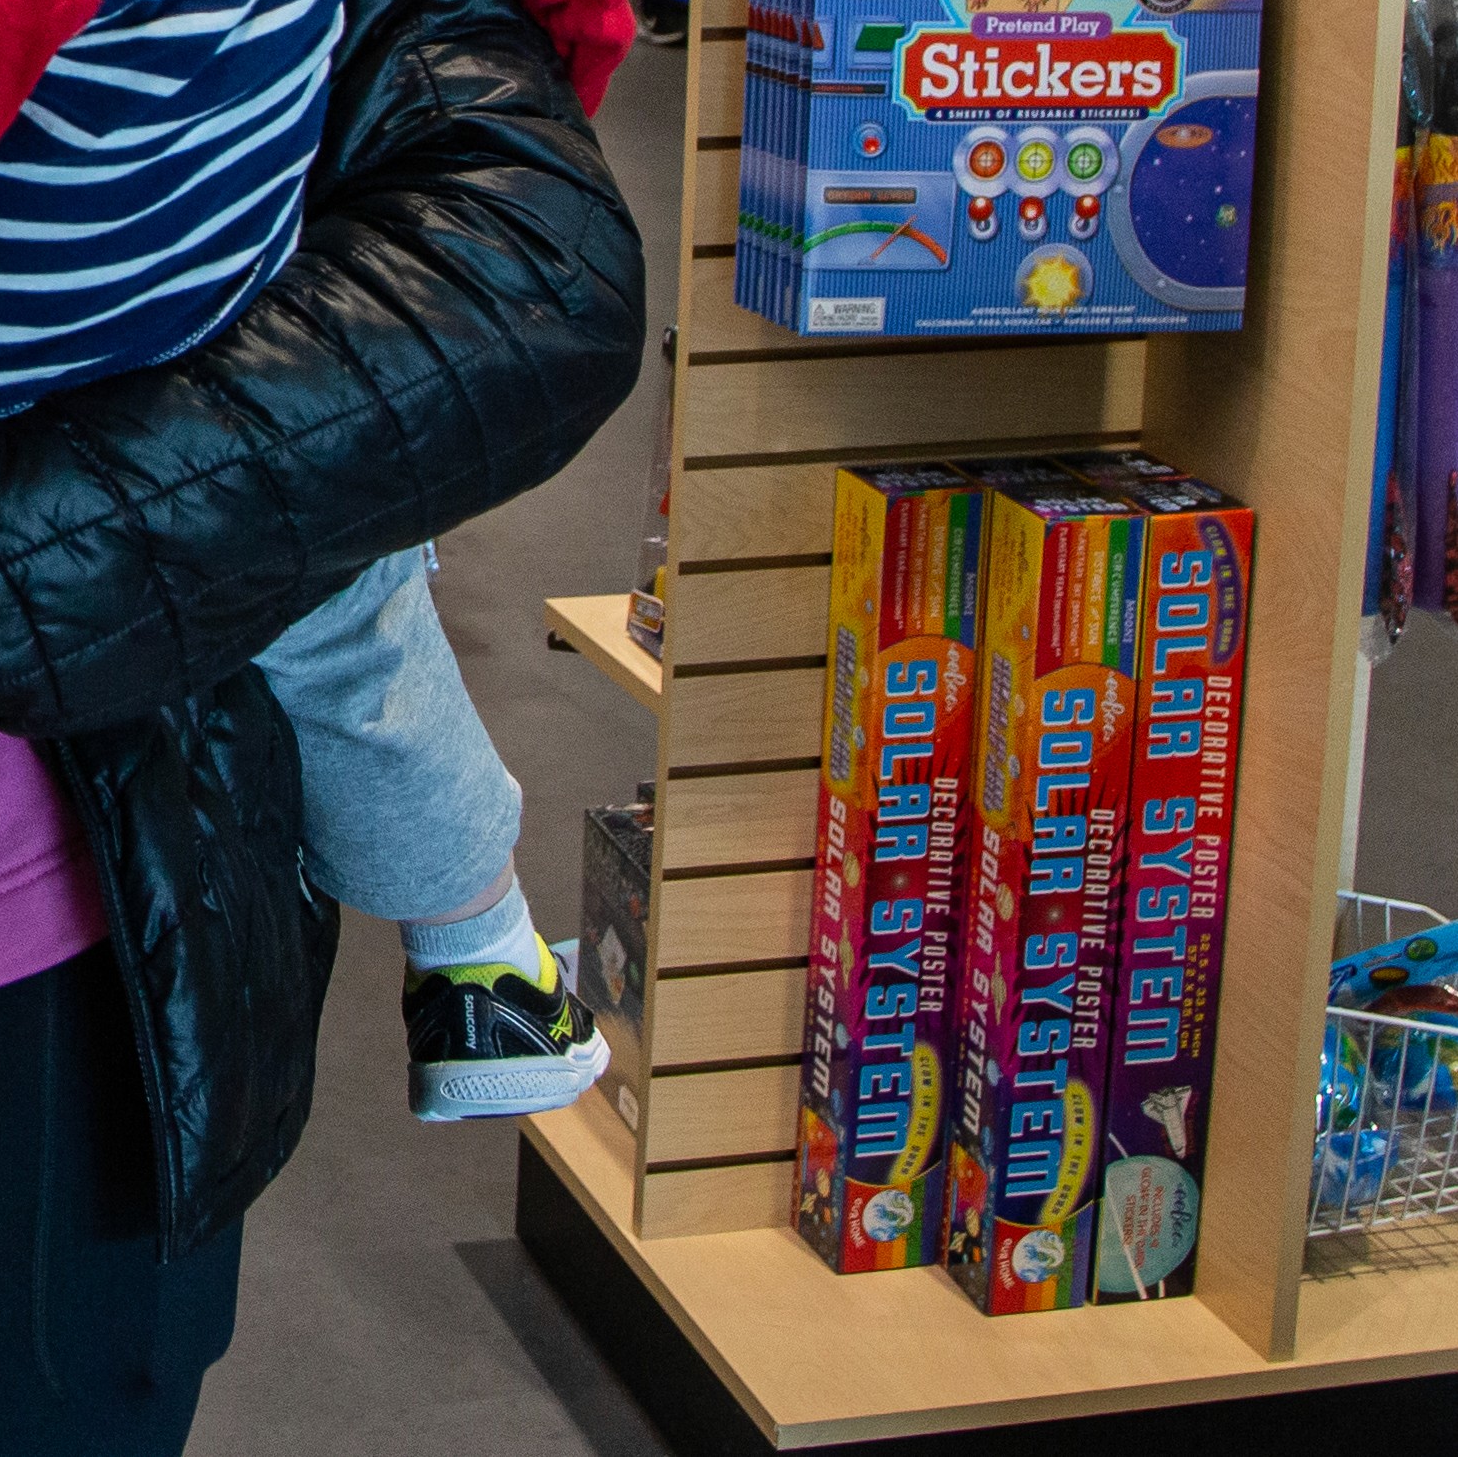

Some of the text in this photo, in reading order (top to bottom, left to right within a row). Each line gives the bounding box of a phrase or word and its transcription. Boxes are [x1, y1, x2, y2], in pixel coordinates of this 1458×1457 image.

[920, 43, 1163, 99] Stickers
[986, 15, 1101, 38] Pretend Play
[935, 109, 1141, 119] 4 SHEETS OF REUSABLE STICKERS!
[1089, 551, 1105, 602] DISTANCE
[1107, 552, 1124, 645] CIRCUMFERENCE
[875, 660, 939, 862] SOLAR
[1028, 688, 1096, 895] SOLAR
[1191, 676, 1233, 919] DECORATIVE POSTER
[1123, 550, 1213, 1066] SOLAR SYSTEM
[823, 794, 847, 922] SOLAR
[919, 778, 959, 1012] DECORATIVE POSTER
[976, 825, 1001, 956] SOLAR
[1071, 809, 1115, 1048] DECORATIVE POSTER
[464, 993, 477, 1050] saucony
[812, 934, 837, 1098] SYSTEM
[855, 898, 923, 1158] SYSTEM
[961, 968, 990, 1136] SYSTEM
[1005, 932, 1079, 1198] SYSTEM
[1072, 1094, 1085, 1126] GLOW
[1067, 1155, 1081, 1176] THE
[1073, 1134, 1084, 1146] IN
[849, 1198, 864, 1248] OUR HOME
[1139, 1204, 1151, 1216] IN
[1150, 1185, 1165, 1238] INCLUDES
[997, 1238, 1013, 1291] OUR HOME
